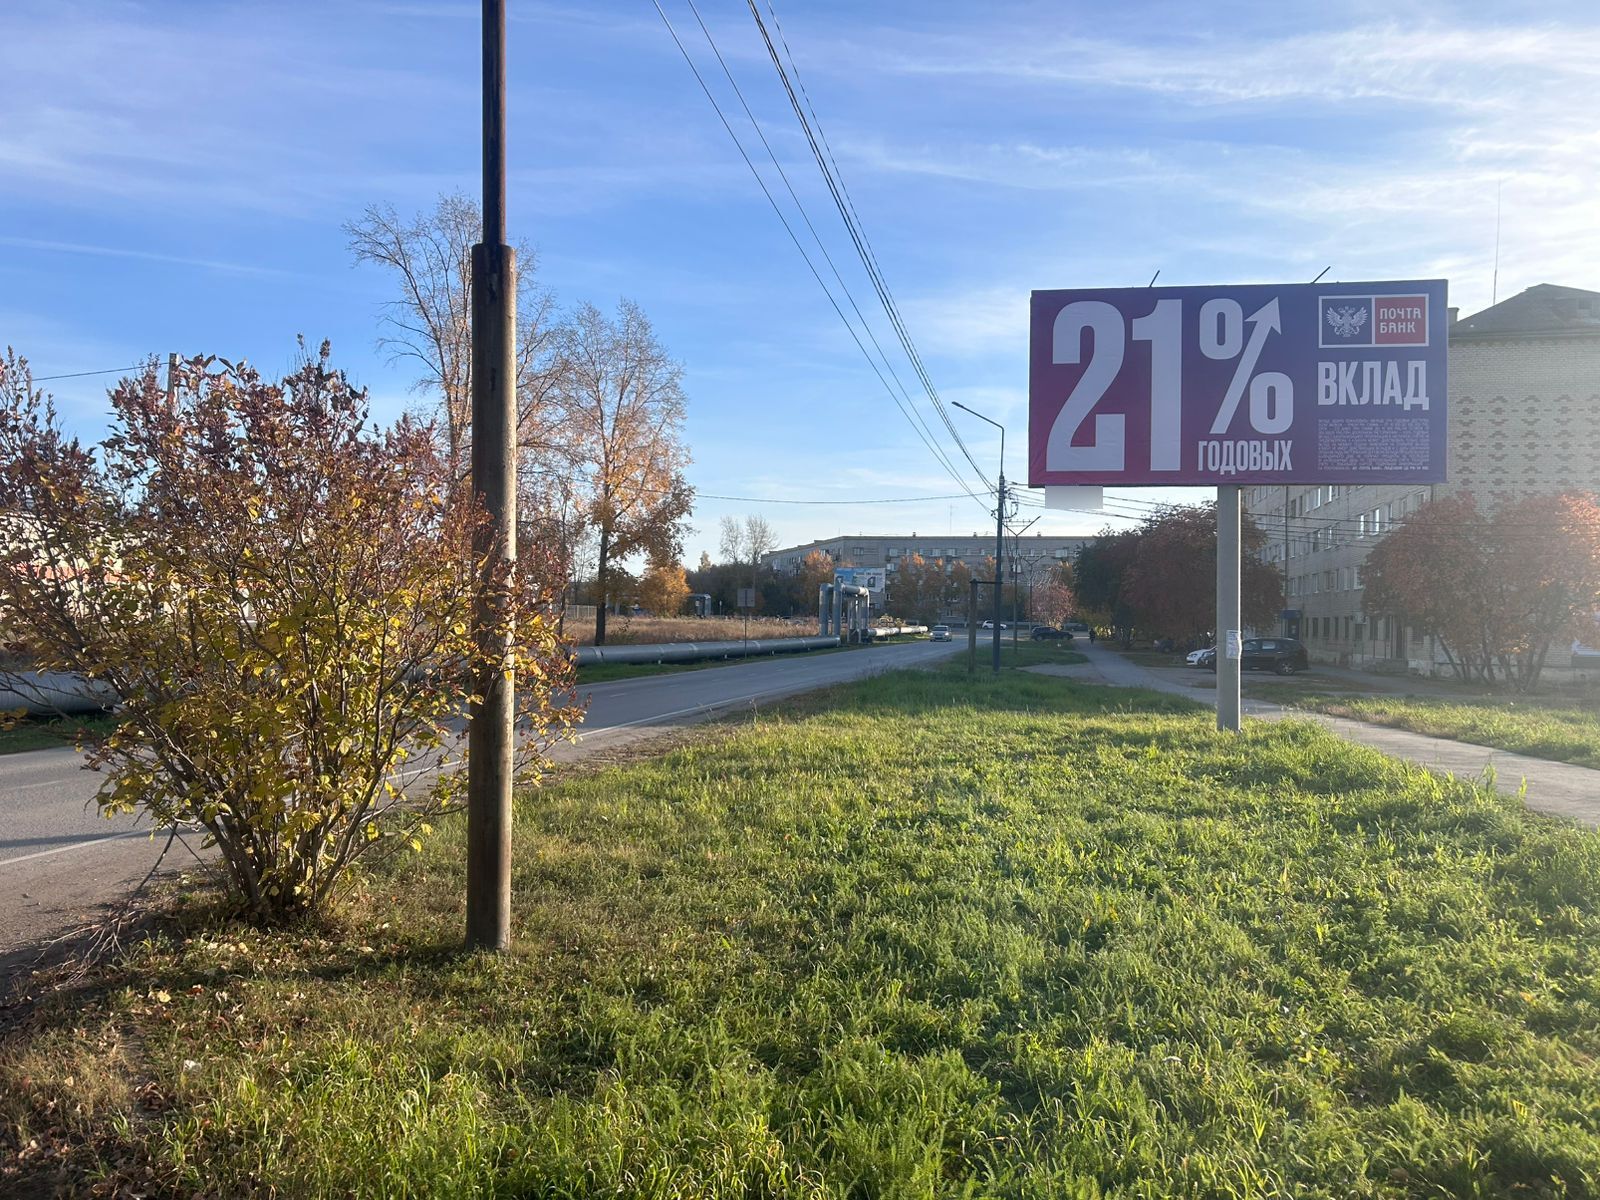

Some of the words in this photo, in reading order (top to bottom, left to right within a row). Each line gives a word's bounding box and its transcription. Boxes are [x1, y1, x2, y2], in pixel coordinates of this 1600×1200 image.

[1379, 307, 1422, 320] ПОЧТА
[1379, 321, 1416, 334] БАНК
[1046, 296, 1294, 472] 21%
[1317, 360, 1430, 411] ВКЛАД
[1197, 439, 1293, 475] ГОДОВЫХ
